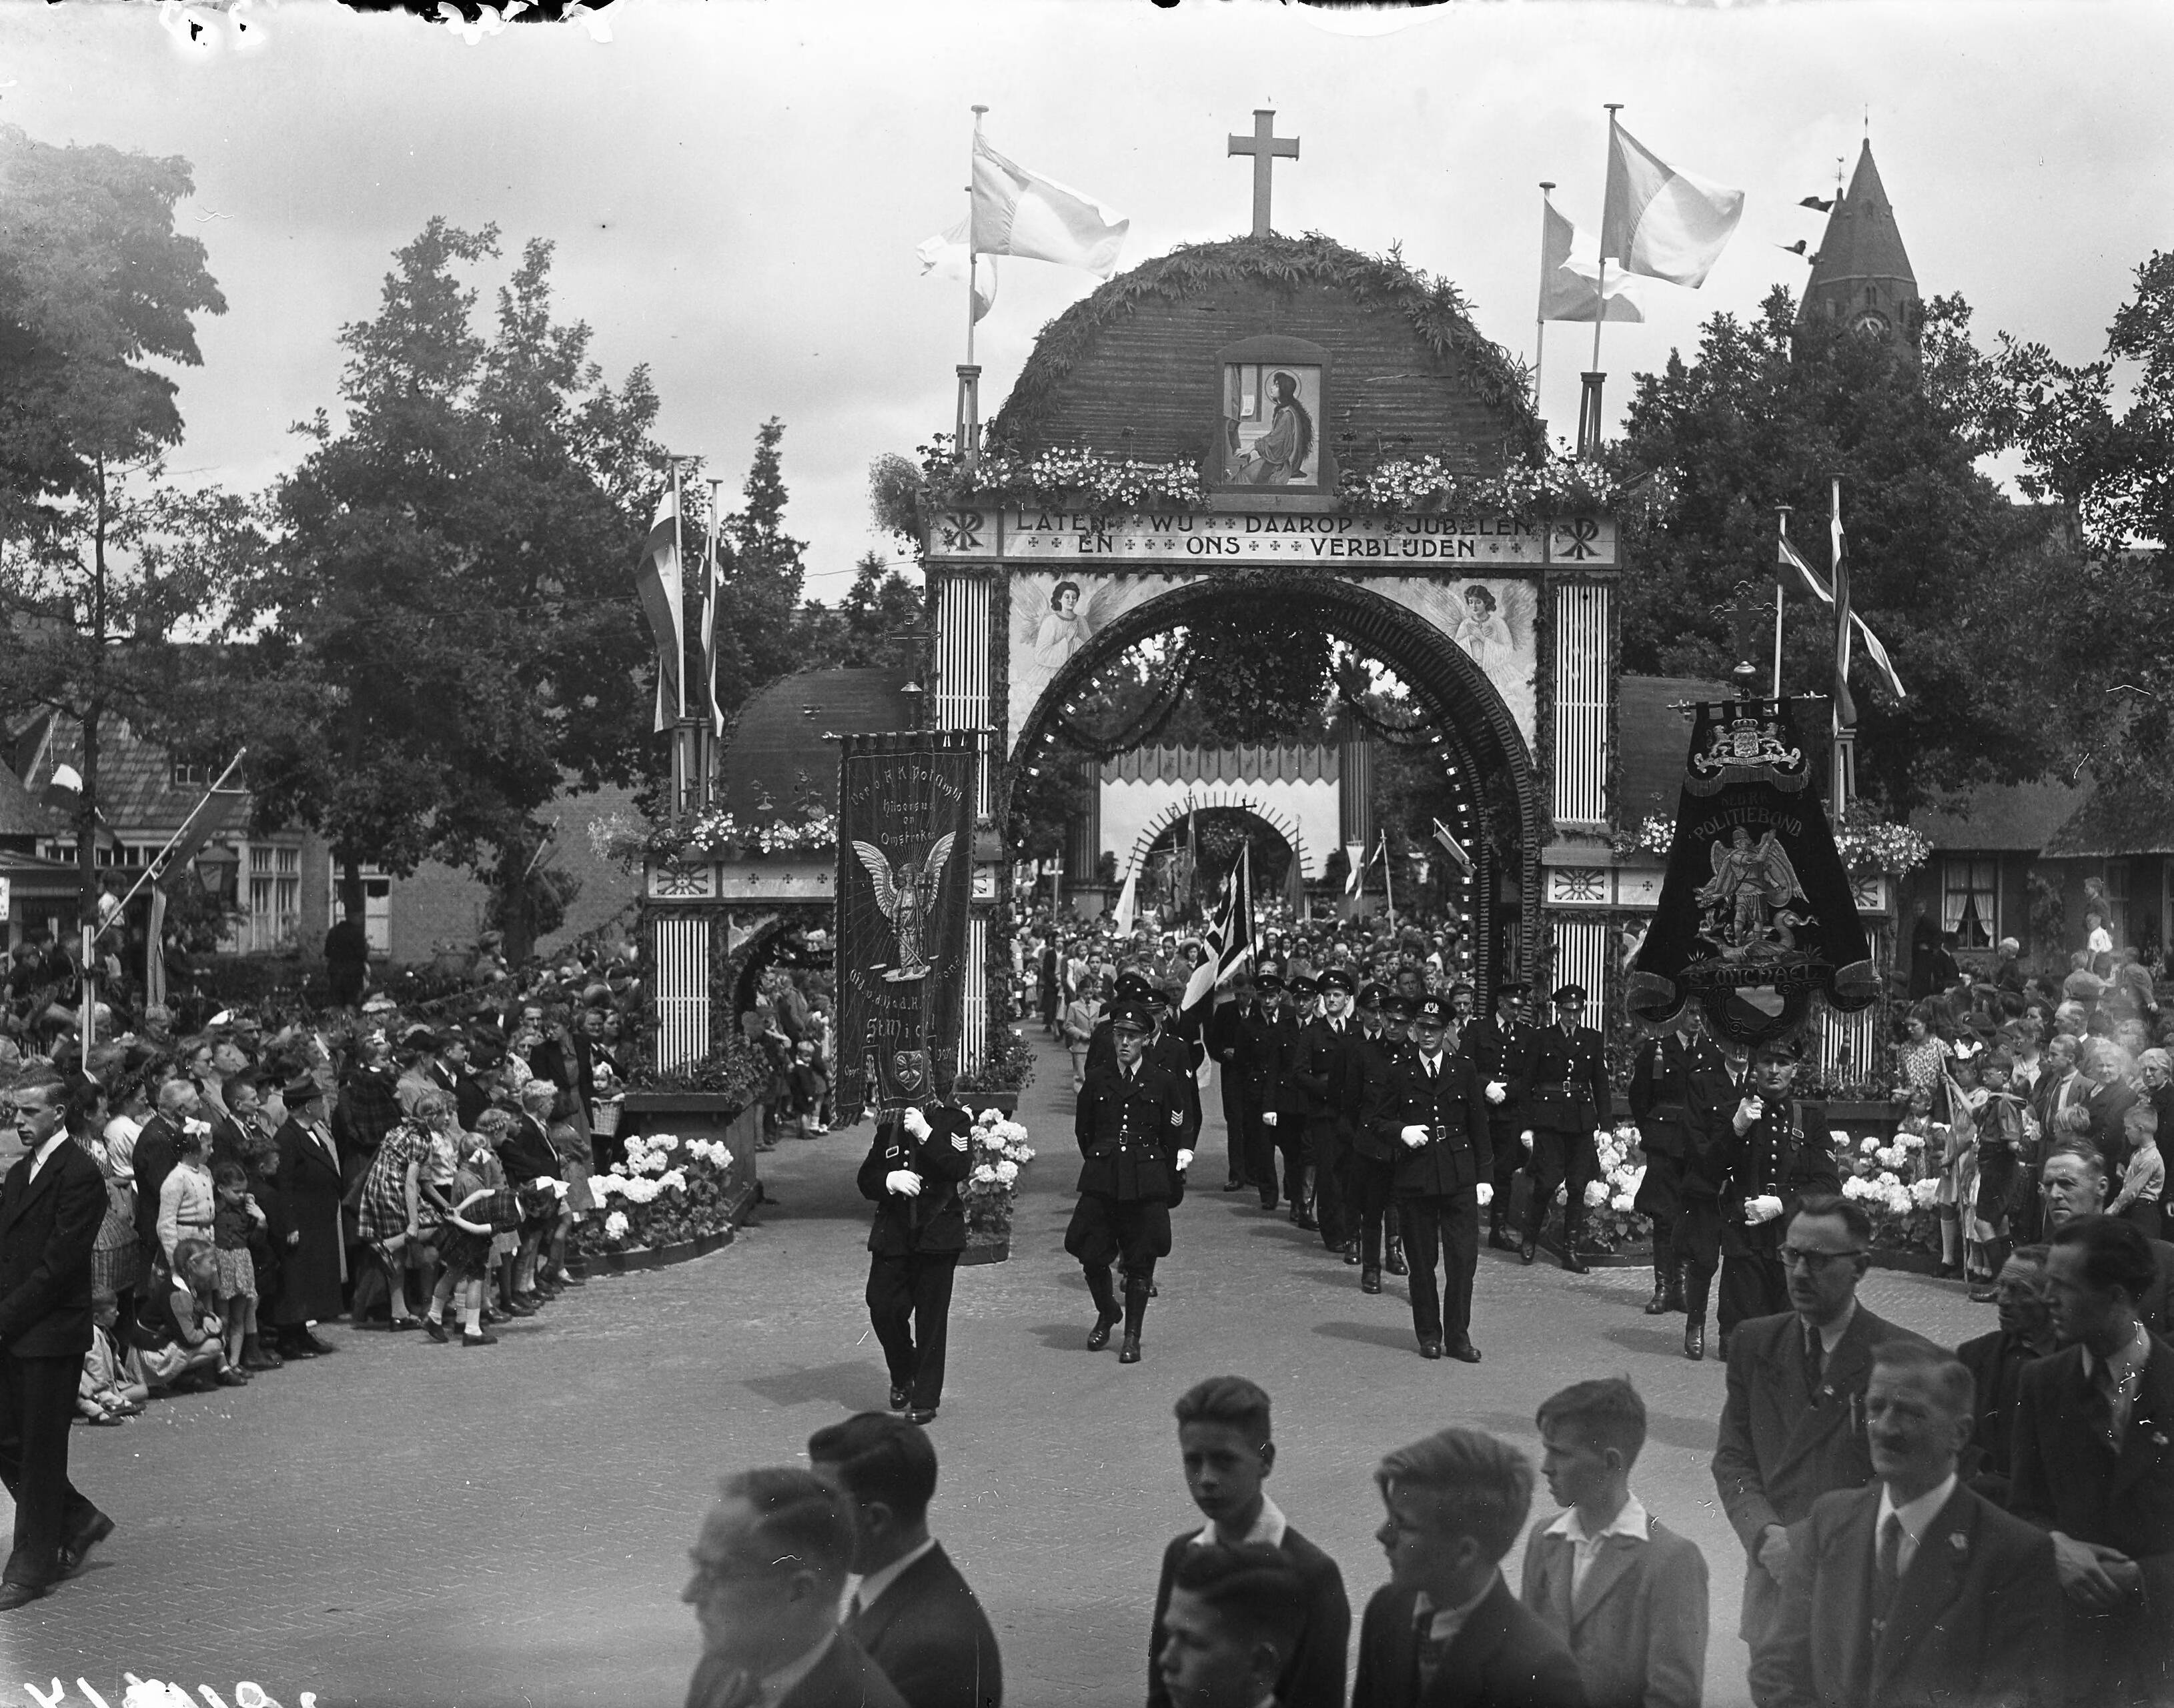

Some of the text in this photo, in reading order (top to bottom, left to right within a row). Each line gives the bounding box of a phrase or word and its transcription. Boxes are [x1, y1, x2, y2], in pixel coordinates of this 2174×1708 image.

[1016, 511, 1105, 531] LATEN
[1245, 516, 1353, 534] DAAROP
[1406, 518, 1530, 536] JUBELEN
[1079, 535, 1113, 553] EN
[1186, 536, 1241, 555] ONS
[1693, 806, 1802, 840] POLITIEBOND
[1715, 965, 1822, 985] MICHAEL
